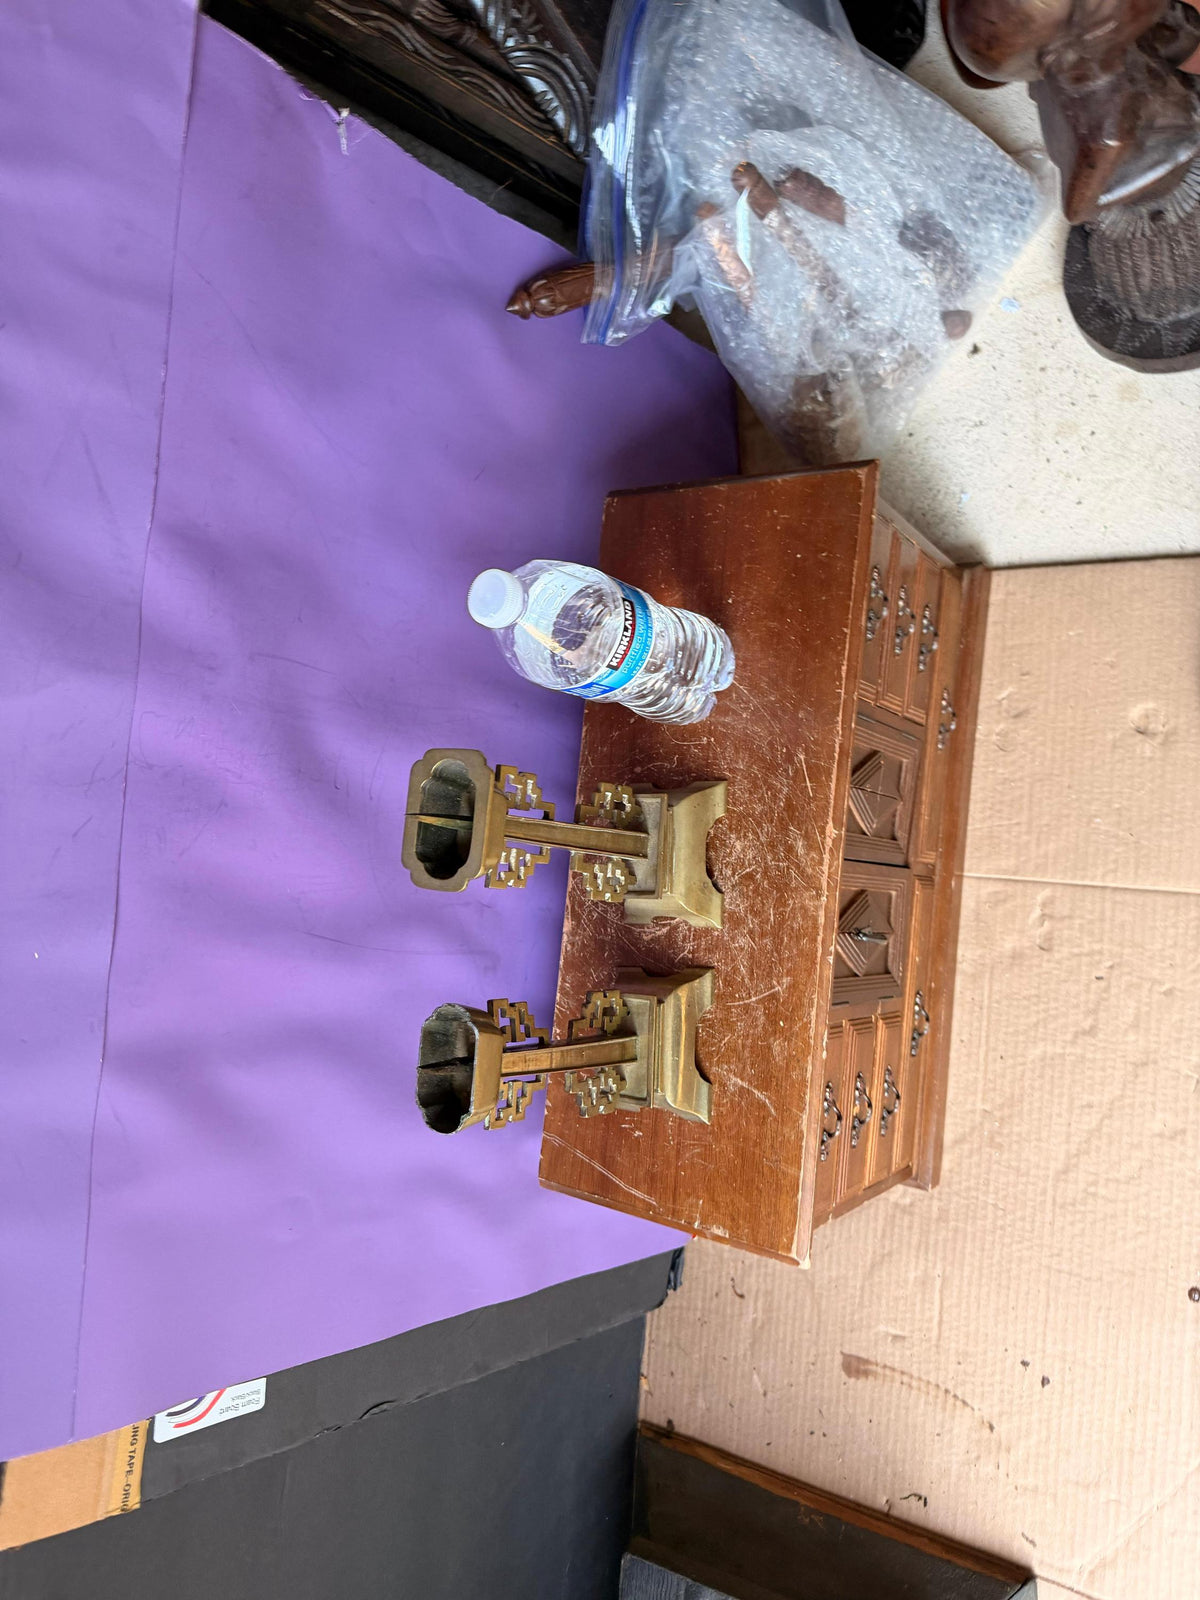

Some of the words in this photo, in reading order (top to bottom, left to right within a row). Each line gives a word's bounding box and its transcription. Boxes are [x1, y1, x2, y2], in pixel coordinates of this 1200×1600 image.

[609, 600, 633, 667] KIRKLAND
[622, 636, 643, 674] purified
[130, 1424, 140, 1446] ING
